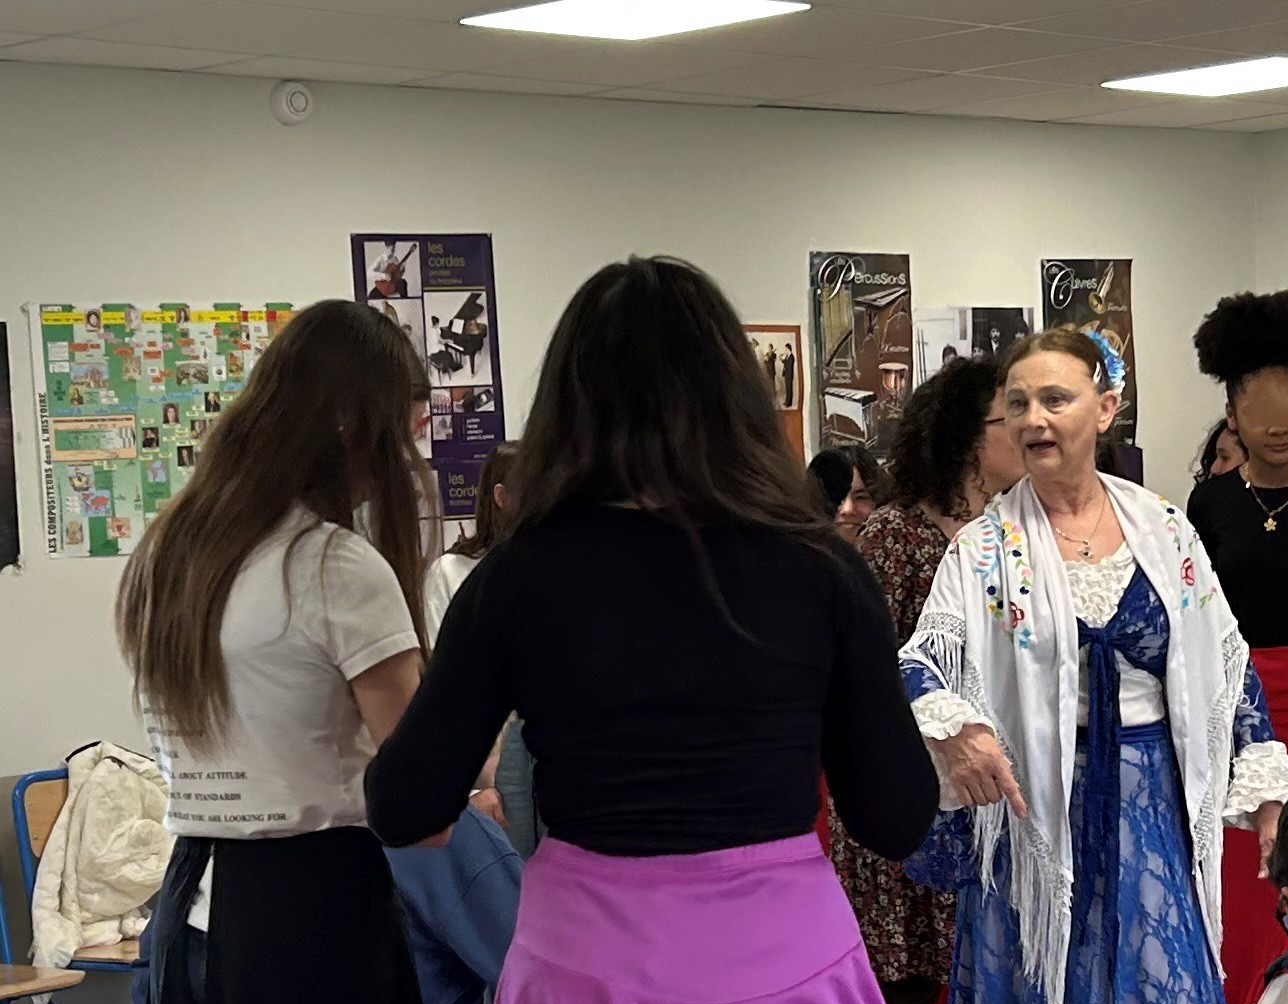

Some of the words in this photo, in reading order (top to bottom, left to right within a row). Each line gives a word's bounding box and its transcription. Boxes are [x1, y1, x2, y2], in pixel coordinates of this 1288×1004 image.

[45, 468, 57, 535] COMPOSITEURS
[48, 538, 57, 553] LES
[223, 814, 265, 822] LOOKING
[267, 813, 287, 821] FOR
